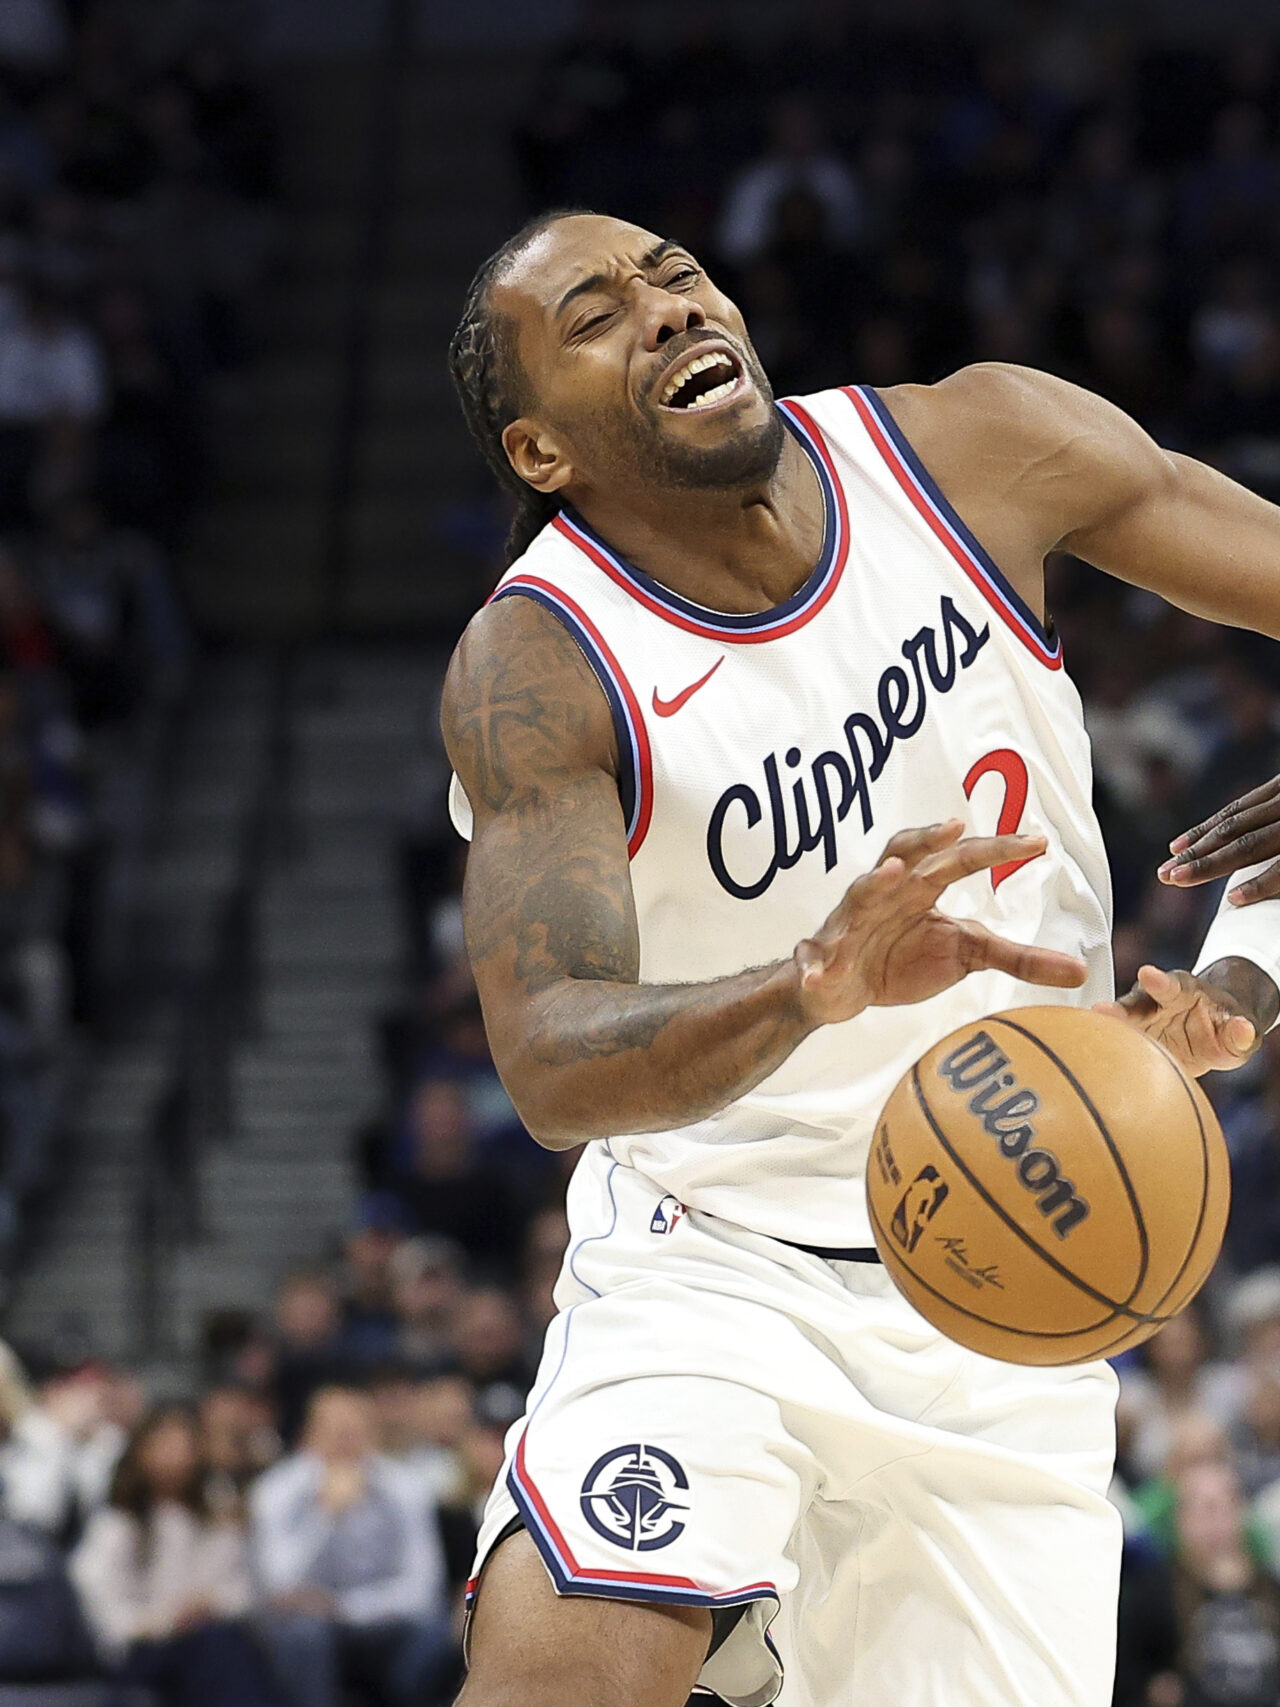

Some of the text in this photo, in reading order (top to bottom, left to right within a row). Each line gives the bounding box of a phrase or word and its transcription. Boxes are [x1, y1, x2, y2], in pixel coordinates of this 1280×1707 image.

[707, 595, 990, 900] Clippers
[962, 749, 1047, 895] 2
[938, 1029, 1092, 1241] Wilson
